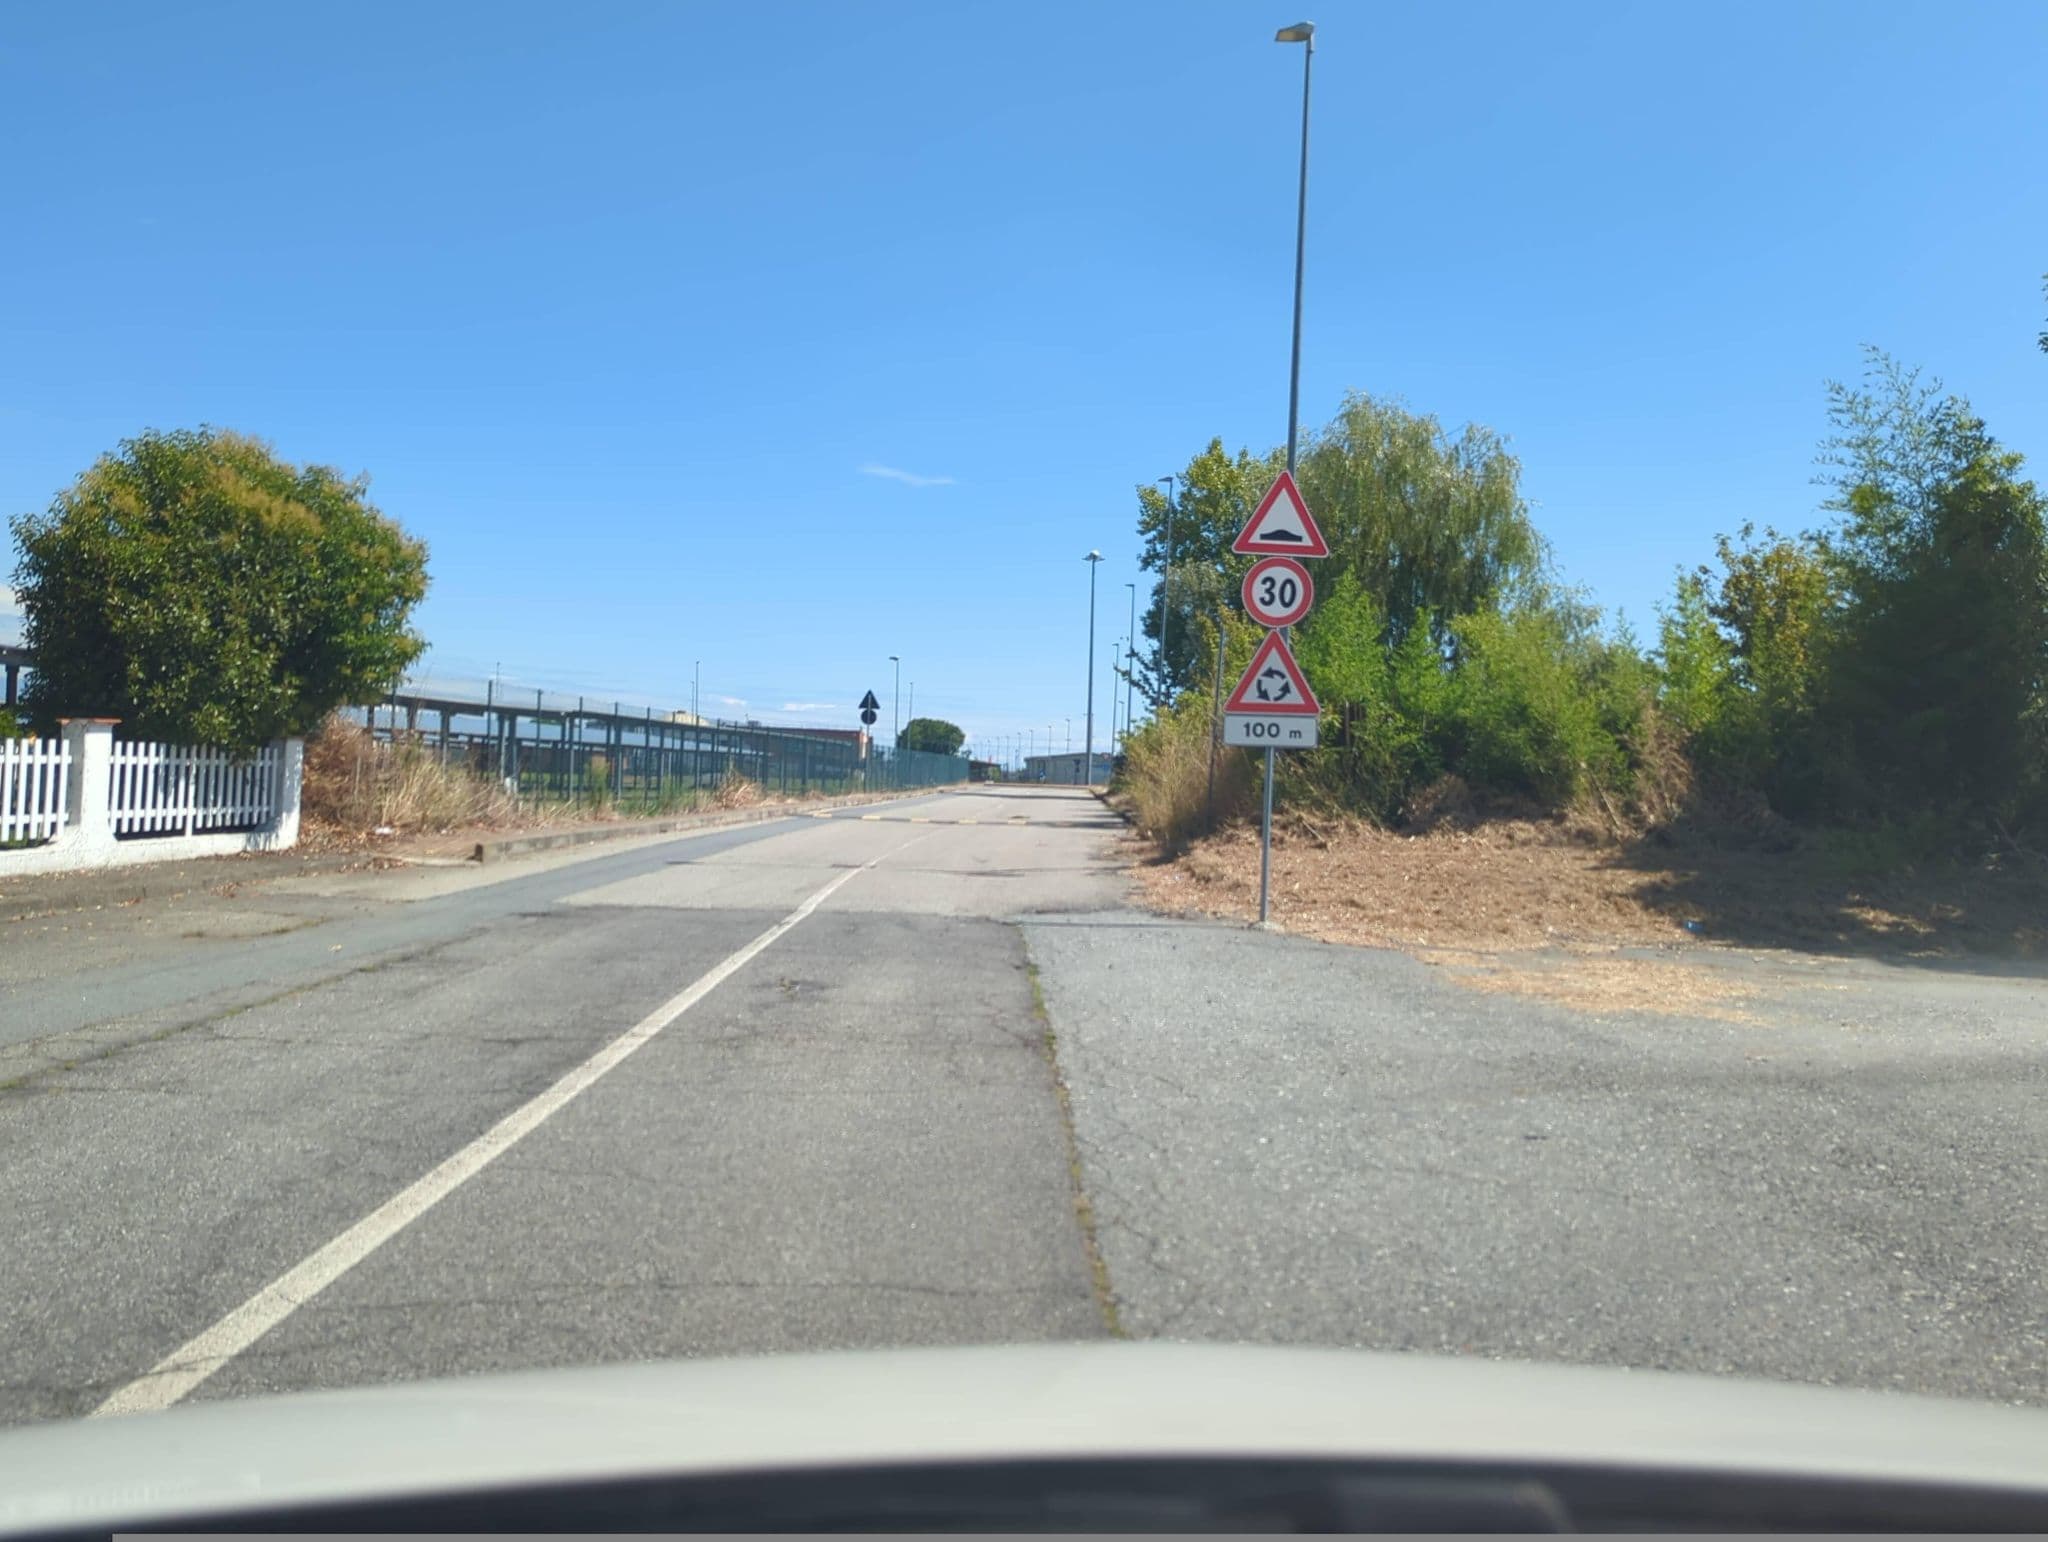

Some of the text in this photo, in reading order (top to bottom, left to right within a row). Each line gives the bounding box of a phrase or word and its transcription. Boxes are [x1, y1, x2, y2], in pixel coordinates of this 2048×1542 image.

[1259, 576, 1297, 608] 30
[1243, 722, 1302, 739] 100 m
